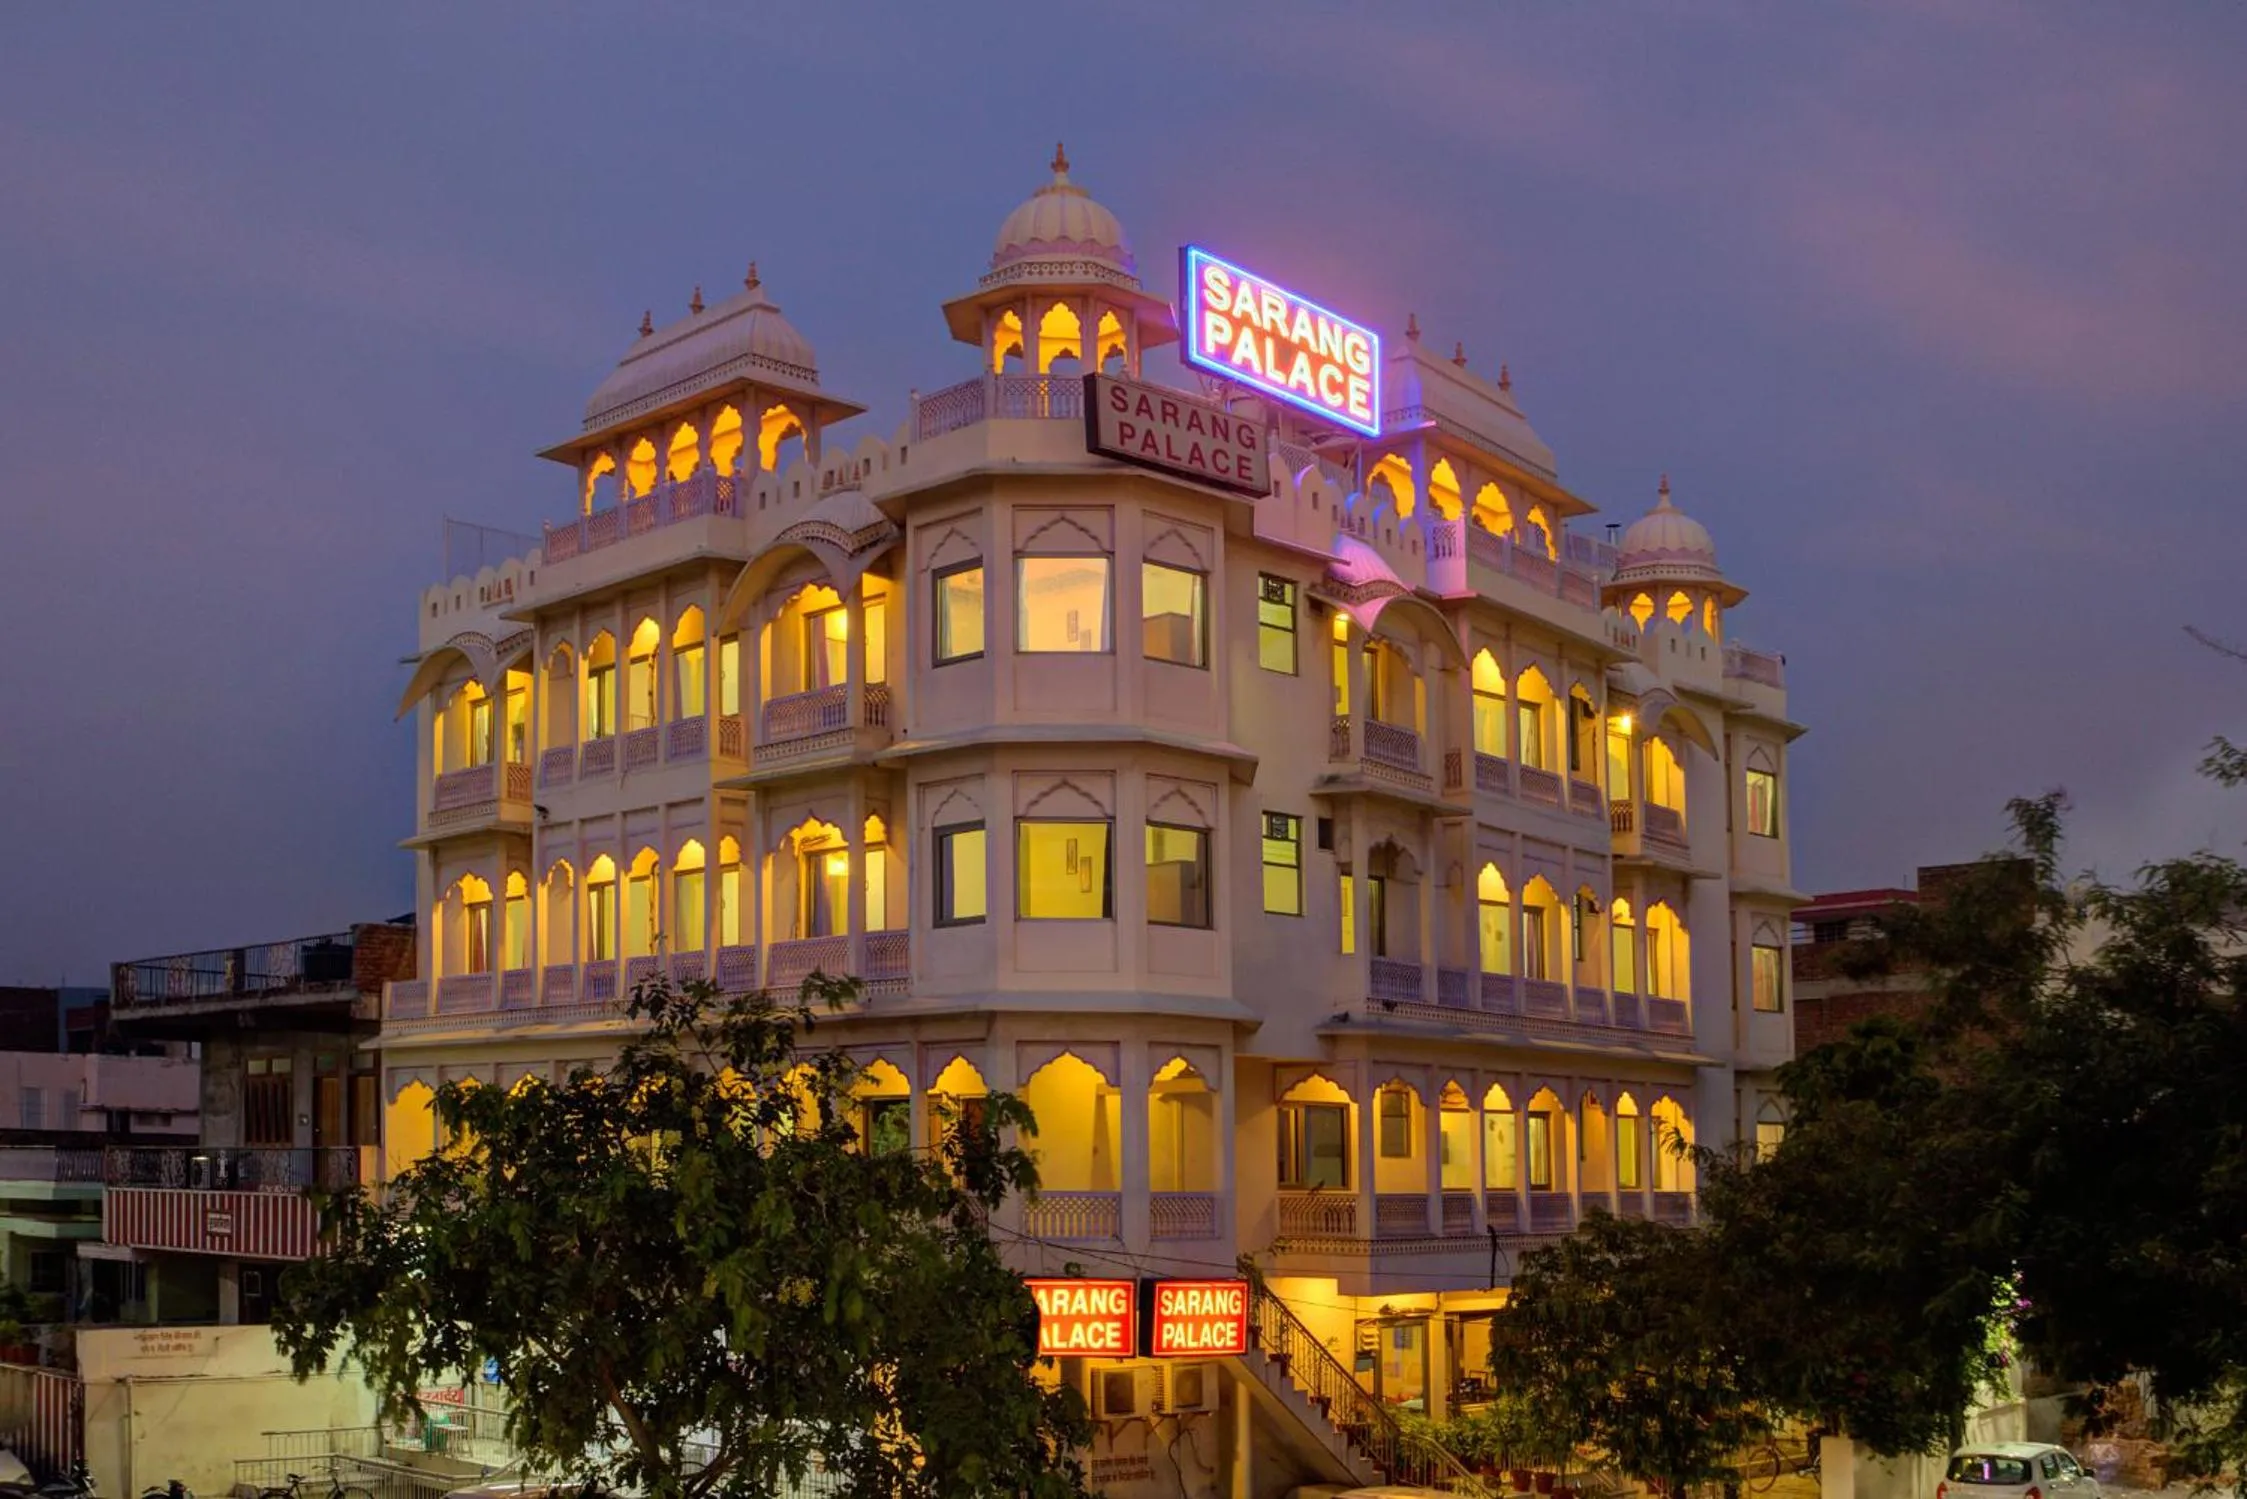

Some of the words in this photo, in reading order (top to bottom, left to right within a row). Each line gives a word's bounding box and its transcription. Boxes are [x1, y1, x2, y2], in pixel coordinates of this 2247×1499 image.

[1203, 265, 1371, 376] SARANG
[1204, 313, 1371, 421] PALACE
[1110, 385, 1256, 451] SARANG
[1119, 422, 1254, 481] PALACE
[1037, 1288, 1127, 1316] ARANG
[1160, 1289, 1243, 1316] SARANG
[1040, 1321, 1122, 1349] LACE
[1162, 1321, 1238, 1349] PALACE
